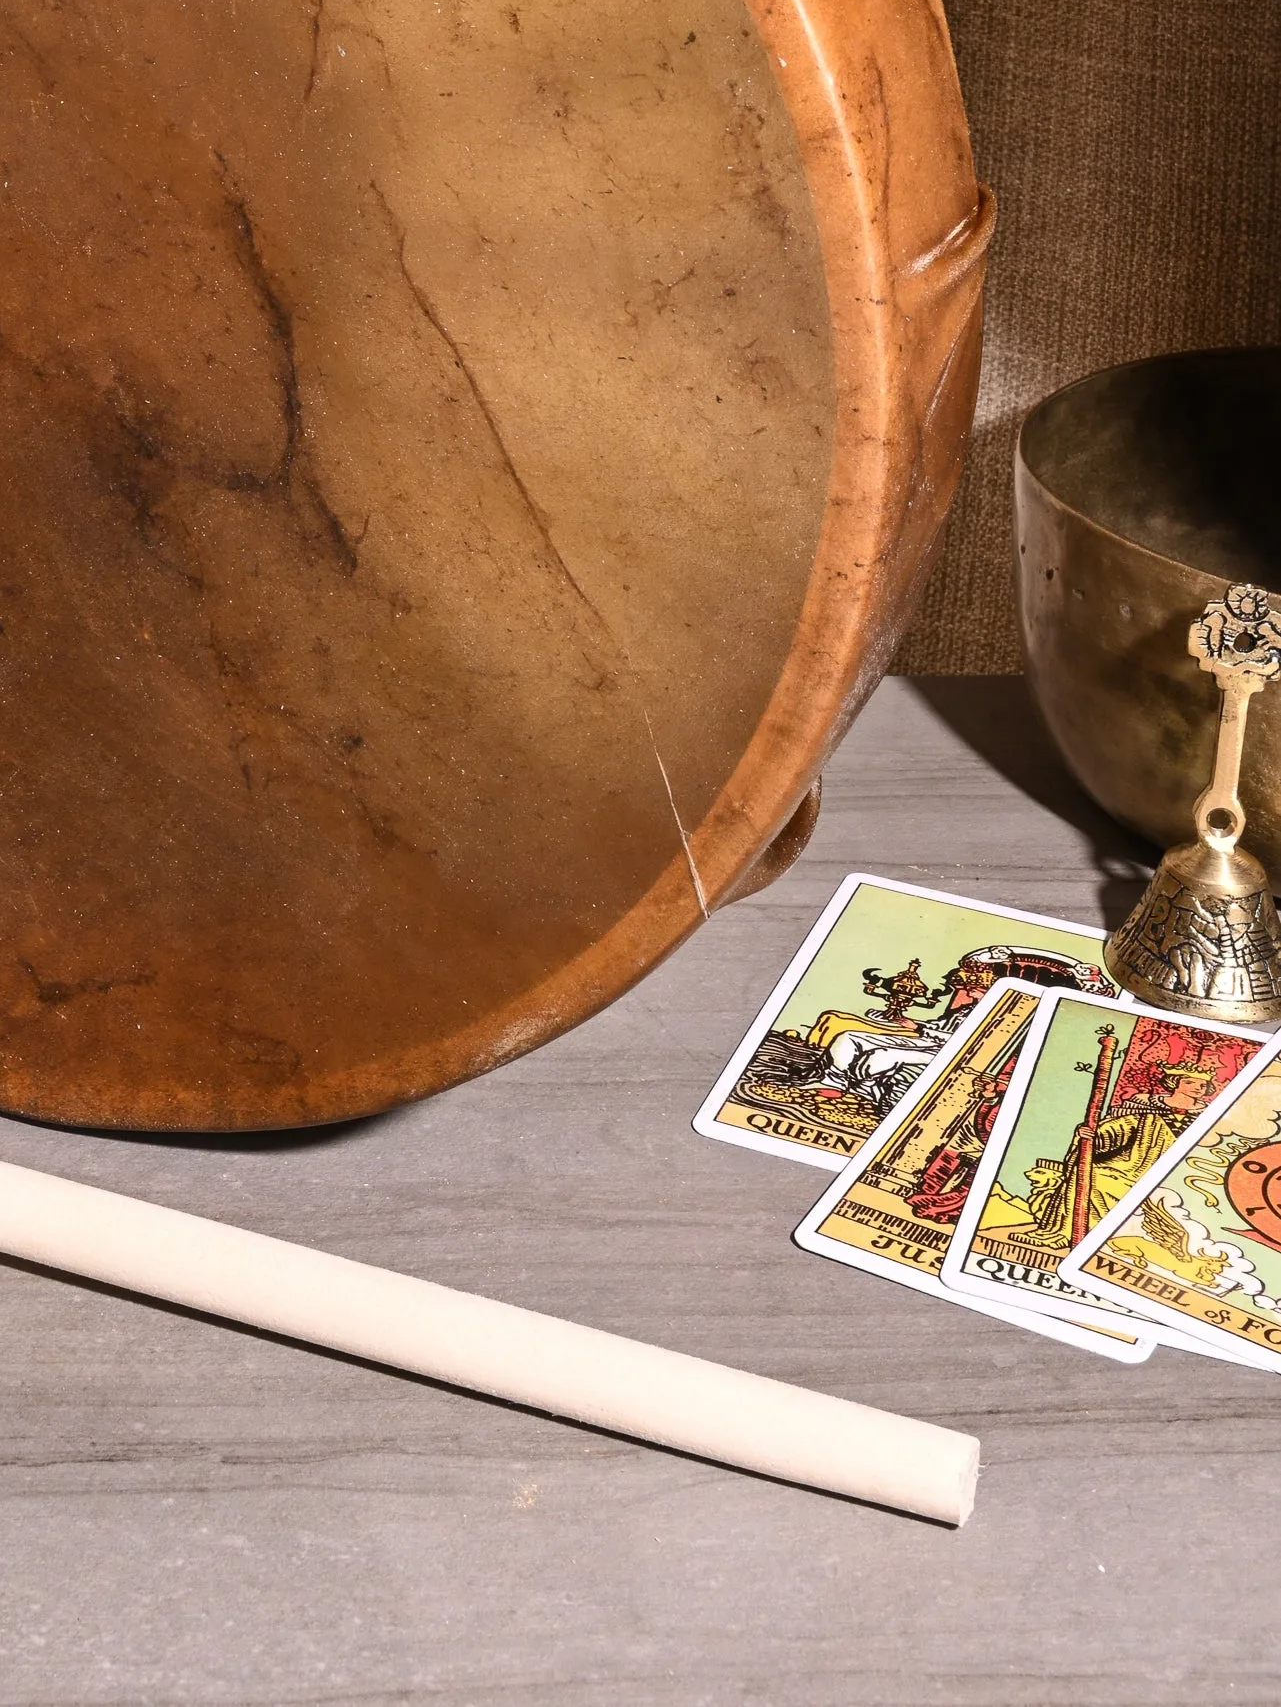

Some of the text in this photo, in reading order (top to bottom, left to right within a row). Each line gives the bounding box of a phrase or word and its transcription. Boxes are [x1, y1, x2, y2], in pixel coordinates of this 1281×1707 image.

[746, 1113, 861, 1153] QUEEN
[976, 1257, 1102, 1302] QUEE
[1095, 1255, 1189, 1307] WHEEL
[1204, 1309, 1232, 1325] of
